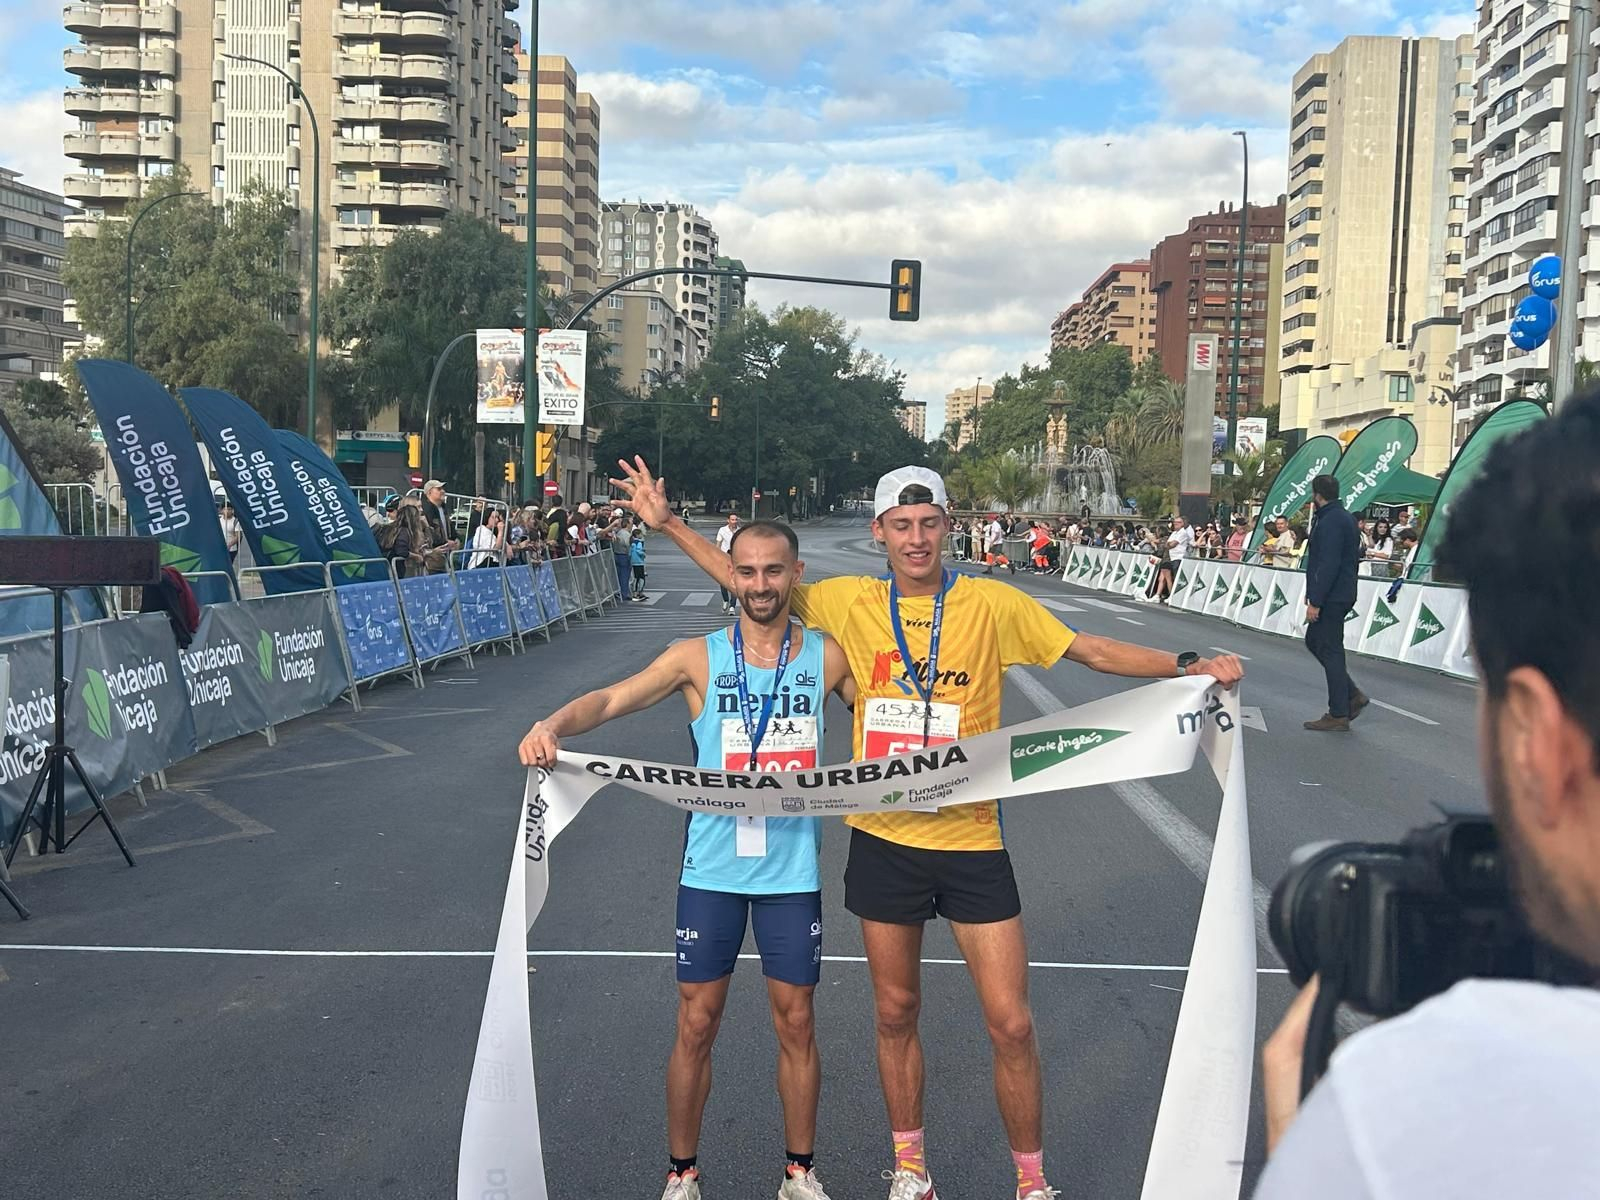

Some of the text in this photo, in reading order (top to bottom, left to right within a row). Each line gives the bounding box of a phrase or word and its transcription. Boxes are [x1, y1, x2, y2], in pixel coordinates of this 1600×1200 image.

[116, 415, 170, 535] Fundación
[150, 441, 190, 530] Unicaja
[220, 427, 271, 529] Fundación
[250, 450, 289, 525] Unicaja
[291, 460, 340, 545] Fundación
[318, 477, 354, 540] Unicaja
[1340, 482, 1367, 510] orte
[274, 624, 325, 655] Fundación
[178, 638, 244, 676] Fundación
[278, 652, 316, 683] Unicaja
[102, 656, 168, 699] Fndación
[186, 670, 232, 706] Unicaja
[716, 674, 738, 687] TROP
[717, 686, 812, 719] nerja
[1026, 741, 1056, 755] Corte
[1057, 732, 1103, 753] Inglés
[586, 745, 969, 790] CARRERA URBANA
[677, 797, 746, 810] málaga
[810, 797, 845, 805] Ciudad
[909, 777, 969, 796] Fundación
[909, 788, 953, 804] Unicaja
